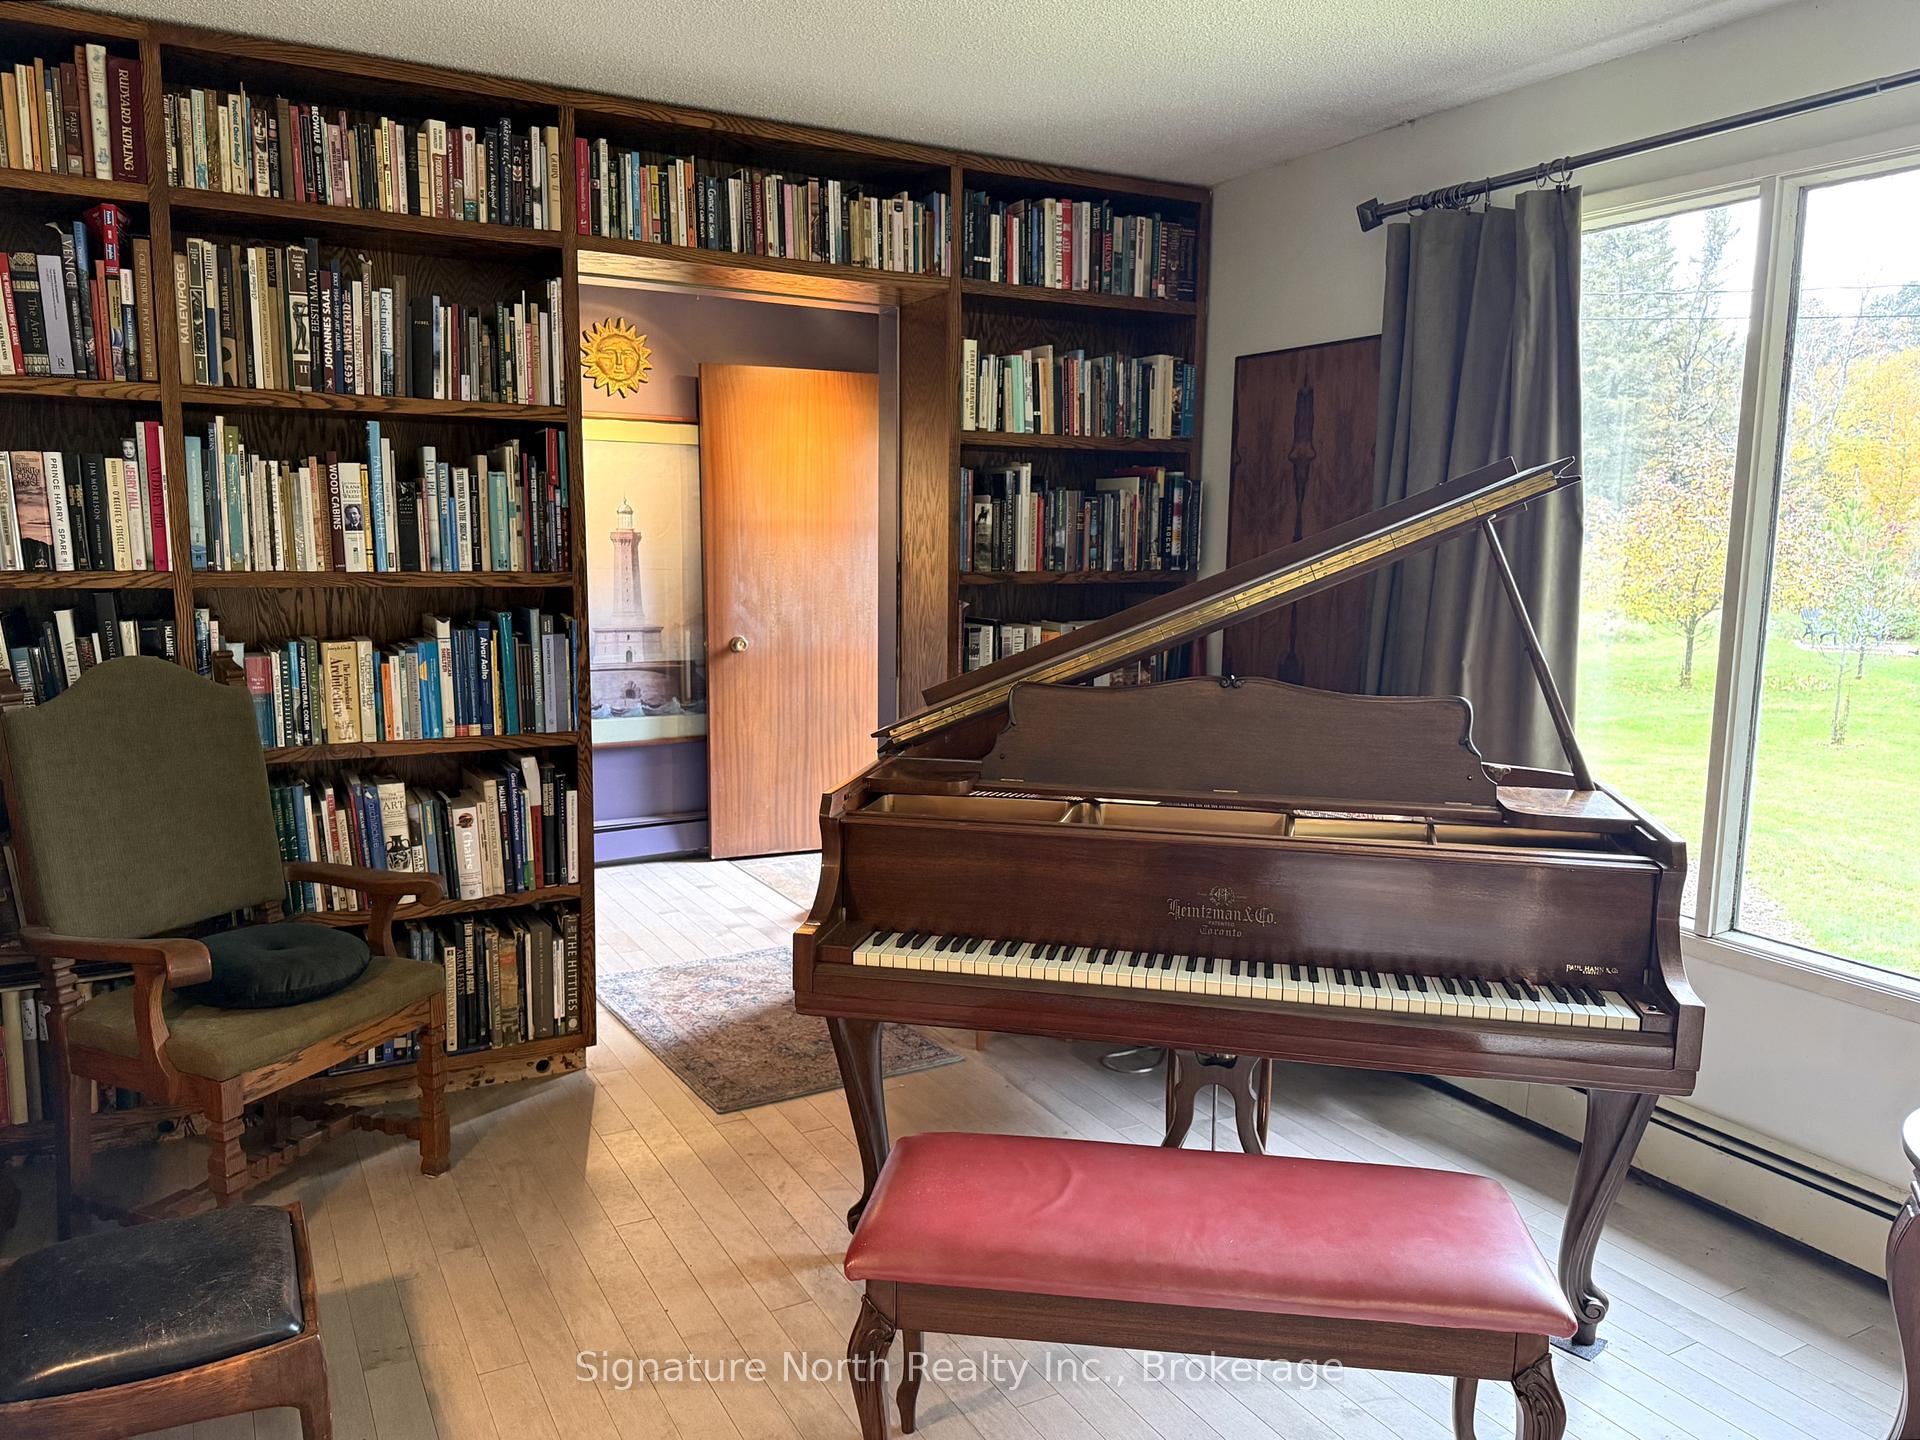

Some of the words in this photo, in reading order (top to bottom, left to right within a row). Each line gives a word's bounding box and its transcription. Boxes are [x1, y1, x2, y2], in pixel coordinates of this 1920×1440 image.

[118, 69, 131, 123] RUDYARD
[70, 112, 78, 138] FAUST
[311, 106, 321, 143] BEOWULF
[122, 126, 134, 170] KIPLING
[488, 173, 497, 208] Mockingbird
[707, 188, 716, 211] CONTACT
[2, 272, 10, 280] THE
[62, 239, 77, 287] VENICE
[138, 253, 146, 275] GREAT
[205, 249, 213, 282] Tallinn
[4, 282, 12, 297] WORLD
[140, 275, 148, 304] HISTORIC
[309, 269, 318, 300] MAAL
[6, 298, 14, 313] NEEDS
[27, 297, 38, 317] The
[176, 264, 190, 344] KALEVIPOEG
[322, 289, 330, 314] SAAL
[381, 291, 391, 315] Eesti
[310, 303, 319, 332] EESTI
[343, 303, 352, 350] MUSTRID
[10, 327, 19, 346] CANADA
[30, 319, 41, 349] Arabs
[323, 317, 333, 369] JOHANNES
[381, 317, 392, 351] mõisad
[345, 354, 353, 384] EESTI
[50, 458, 60, 490] PRINCE
[88, 462, 96, 476] JIM
[125, 464, 137, 490] JERRY
[329, 464, 338, 494] WOOD
[456, 470, 464, 480] THE
[90, 479, 101, 520] MORRISON
[128, 491, 139, 511] HALL
[150, 464, 164, 509] AUDREY
[373, 455, 385, 540] FALLINGWATER
[457, 481, 465, 500] TOWER
[53, 493, 64, 522] HARRY
[112, 491, 122, 517] O'KEEFFE
[331, 496, 342, 530] CABINS
[154, 513, 163, 528] 100
[58, 528, 67, 556] SPARE
[115, 525, 125, 553] STIEGLITZ
[164, 626, 174, 656] MALAPARTE
[480, 636, 488, 658] Alvar
[16, 660, 29, 677] INTO
[64, 641, 78, 672] VOGUE
[365, 653, 374, 686] Critical
[481, 659, 489, 679] Aalto
[19, 679, 31, 690] THE
[300, 657, 309, 709] ARCHITECTURAL
[329, 657, 343, 717] Architecture
[343, 673, 352, 704] Encyclopedia
[367, 687, 375, 710] Path
[383, 800, 404, 810] ART
[498, 786, 507, 812] MALAPARTE
[368, 803, 380, 848] architecture
[463, 831, 475, 870] Chairs
[1167, 898, 1242, 921] Heintzman
[1254, 907, 1277, 927] Co.
[1199, 924, 1242, 938] Toronto
[567, 935, 577, 957] THE
[1566, 964, 1583, 973] PAUL
[567, 960, 578, 1011] HITTITES
